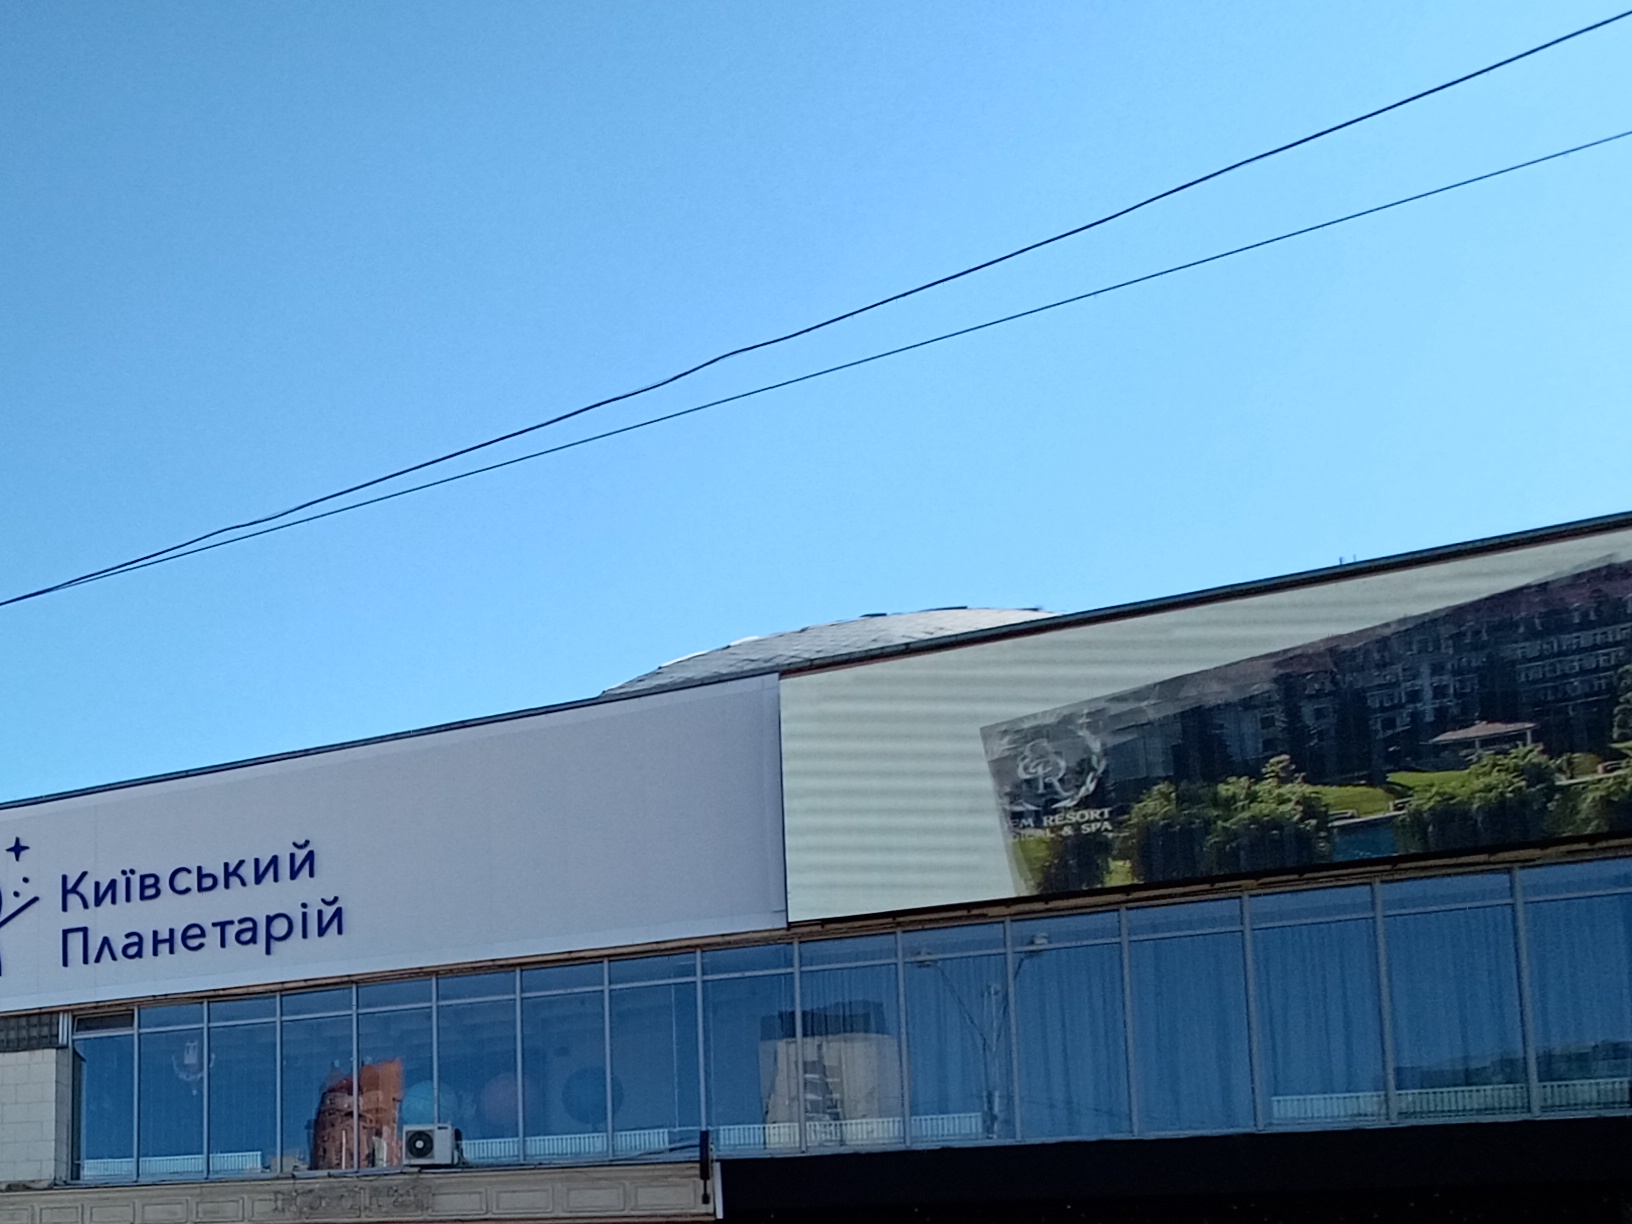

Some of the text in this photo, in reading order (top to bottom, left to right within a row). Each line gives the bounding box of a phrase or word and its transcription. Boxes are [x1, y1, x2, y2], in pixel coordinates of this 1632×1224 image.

[1042, 807, 1112, 827] RESORT
[1081, 821, 1113, 834] SPA
[60, 839, 317, 912] Київський
[60, 896, 344, 968] Планетарій
